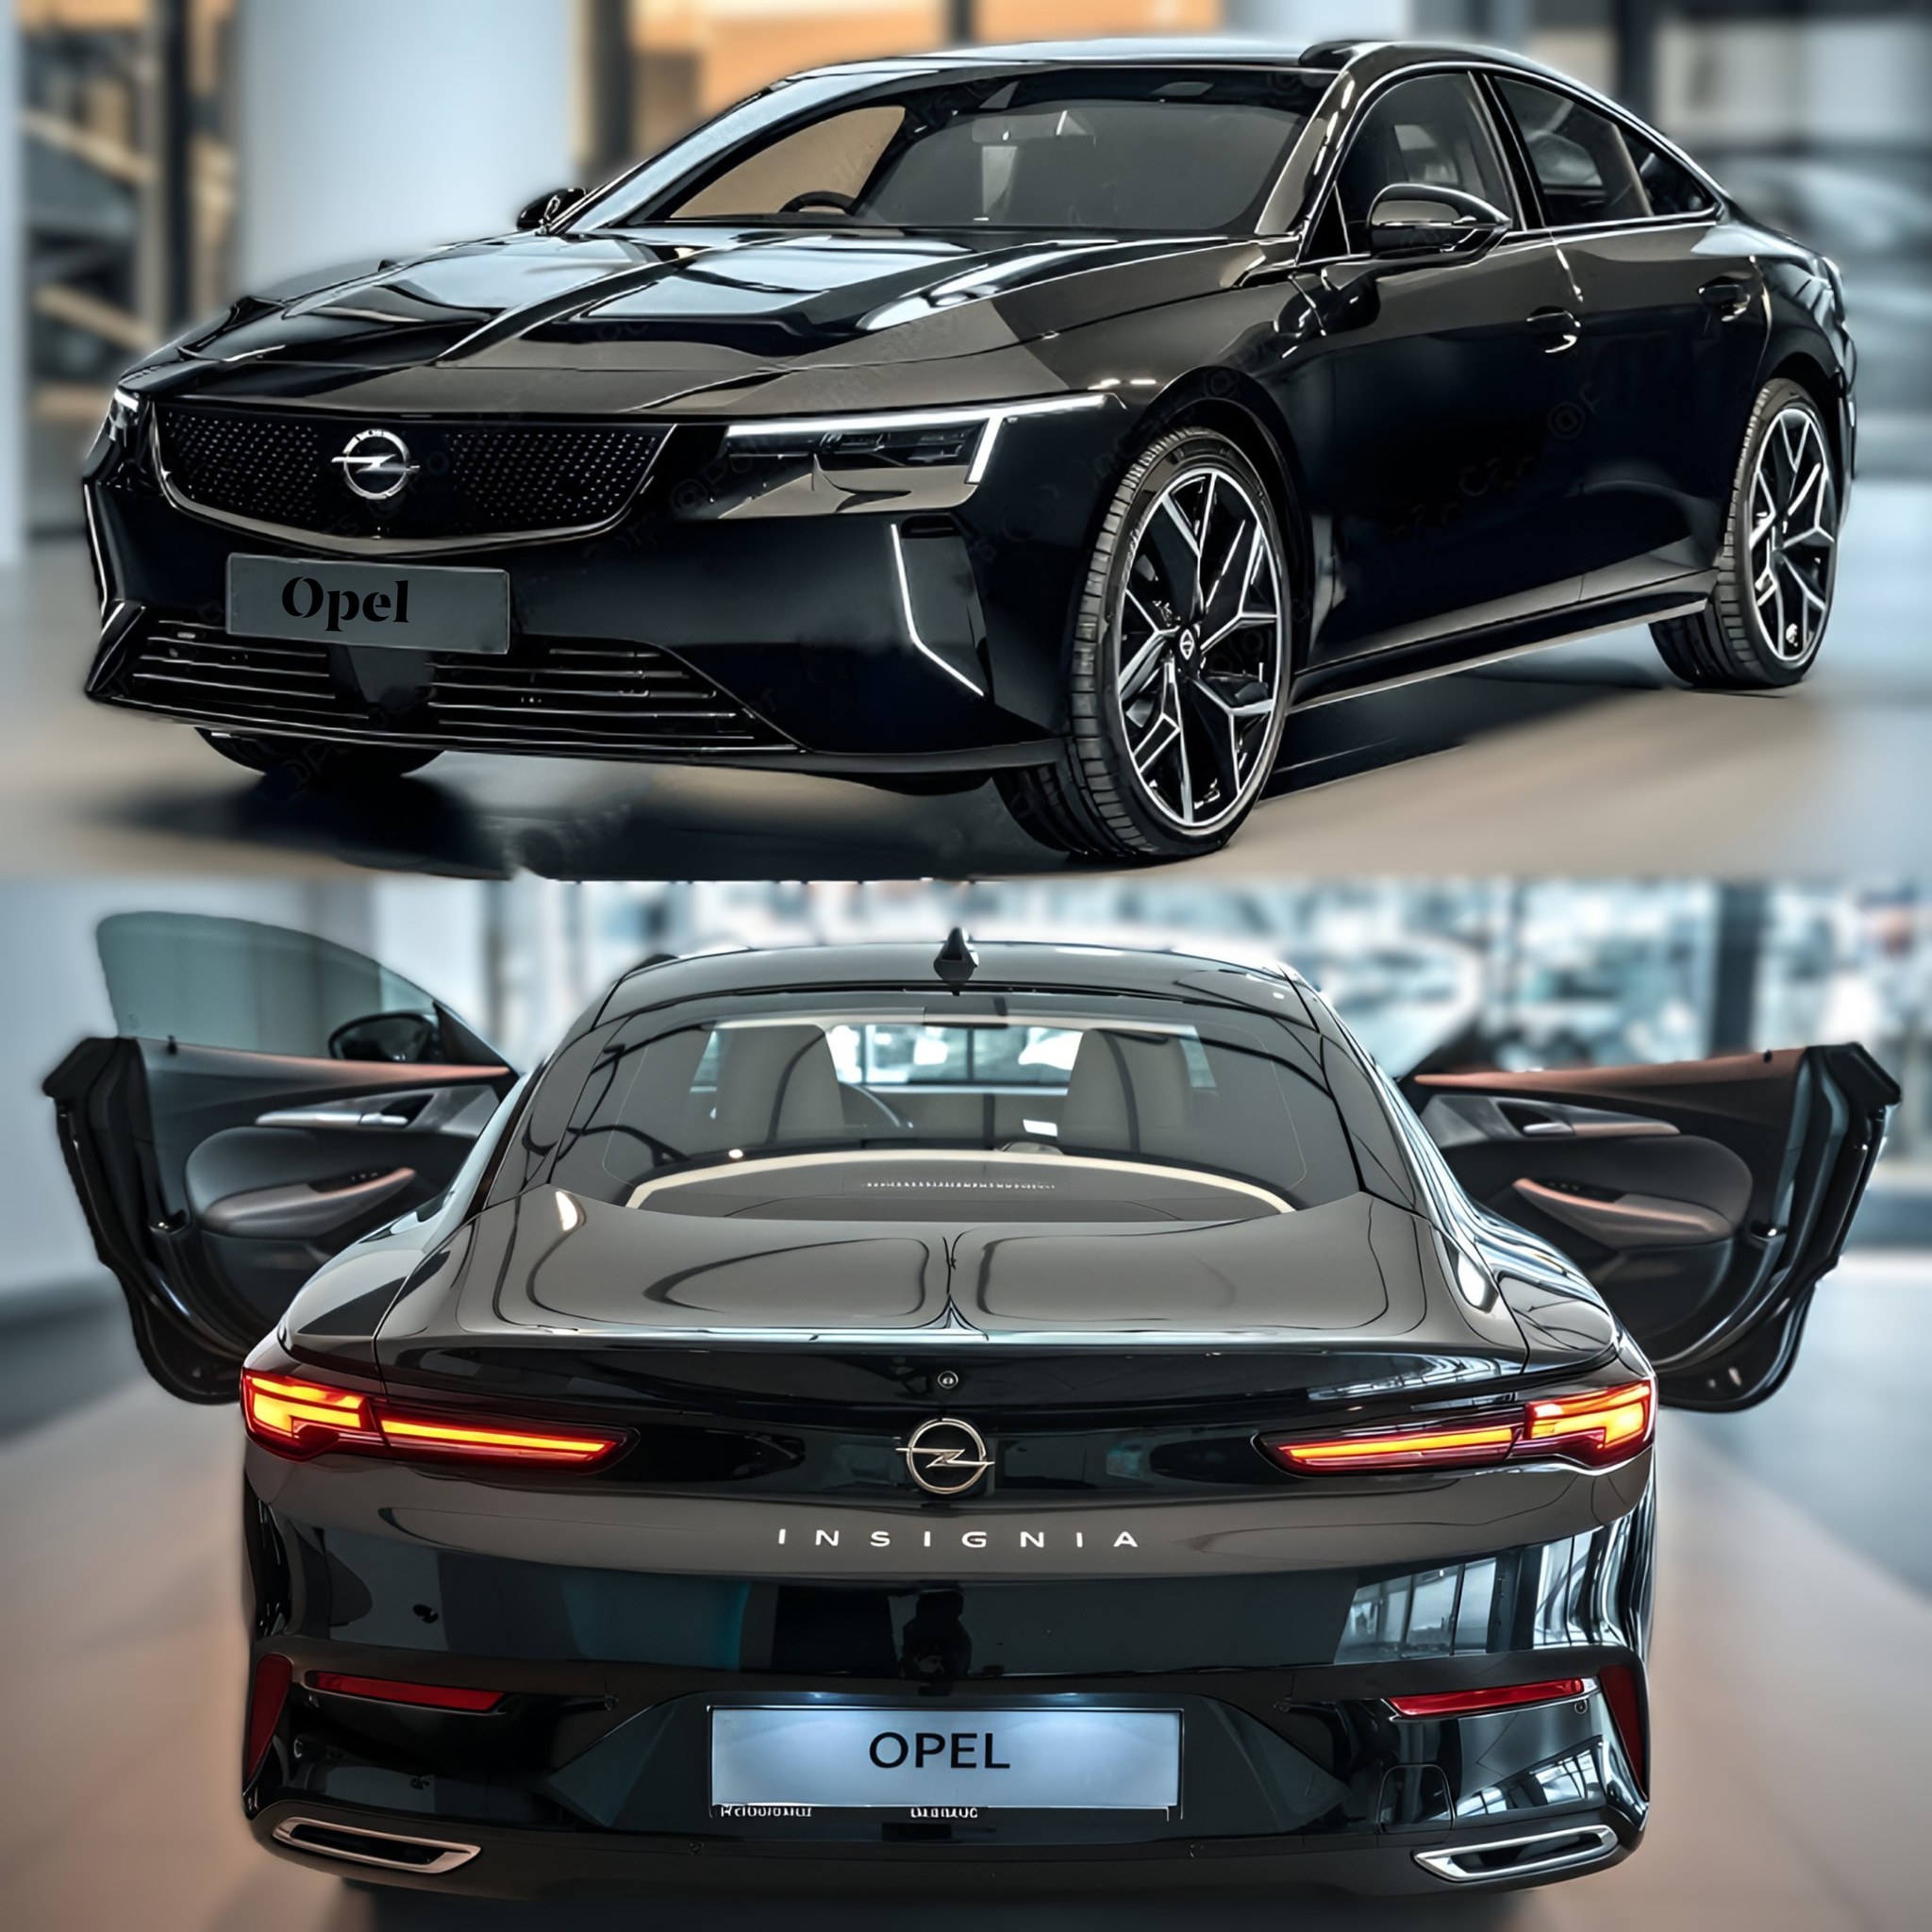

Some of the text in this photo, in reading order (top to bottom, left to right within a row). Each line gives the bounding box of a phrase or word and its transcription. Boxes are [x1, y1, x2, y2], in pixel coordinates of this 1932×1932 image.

[281, 576, 409, 632] Opel
[778, 1528, 1138, 1548] INSIGNIA
[868, 1731, 1011, 1770] OPEL
